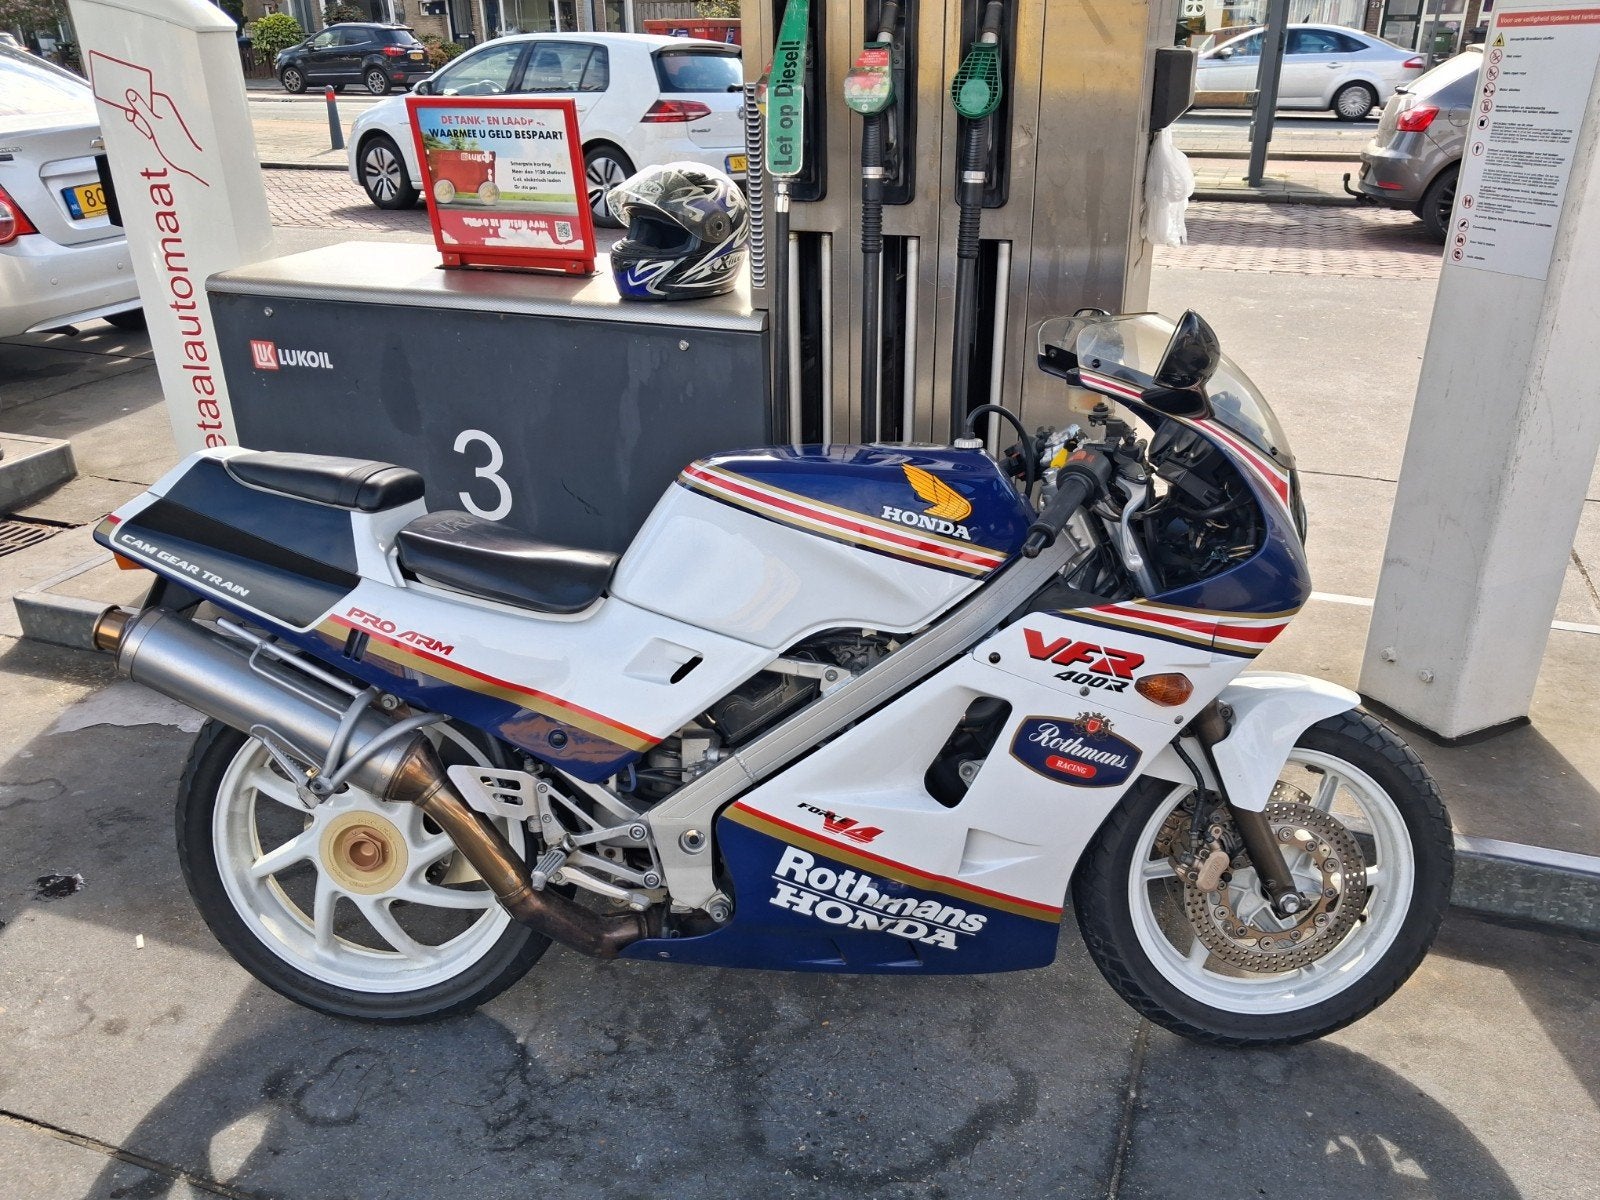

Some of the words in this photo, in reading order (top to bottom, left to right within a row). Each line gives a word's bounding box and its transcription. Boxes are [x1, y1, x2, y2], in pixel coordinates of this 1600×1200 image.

[774, 41, 801, 98] Diesel!
[429, 128, 477, 138] WAARMEE
[479, 129, 486, 138] U
[489, 129, 512, 139] GELD
[515, 130, 563, 140] BESPAART
[441, 115, 453, 125] DE
[487, 116, 499, 125] EN
[780, 104, 798, 129] op
[468, 153, 493, 162] LUKOL
[773, 135, 792, 166] Let
[141, 167, 228, 448] etaalautomaat
[278, 348, 334, 370] LUKOIL
[453, 429, 512, 521] 3
[881, 505, 972, 541] HONDA
[121, 534, 158, 554] CAM
[157, 551, 199, 574] GEAR
[202, 570, 250, 597] TRAIN
[346, 606, 397, 633] PRO
[396, 630, 454, 656] ARM
[1023, 627, 1145, 680] VFR
[1053, 670, 1129, 693] 400R
[1028, 722, 1128, 769] Rothmans
[1056, 760, 1087, 774] RACING
[823, 809, 885, 843] V4
[772, 845, 988, 932] Rothmans
[769, 883, 958, 950] HONDA
